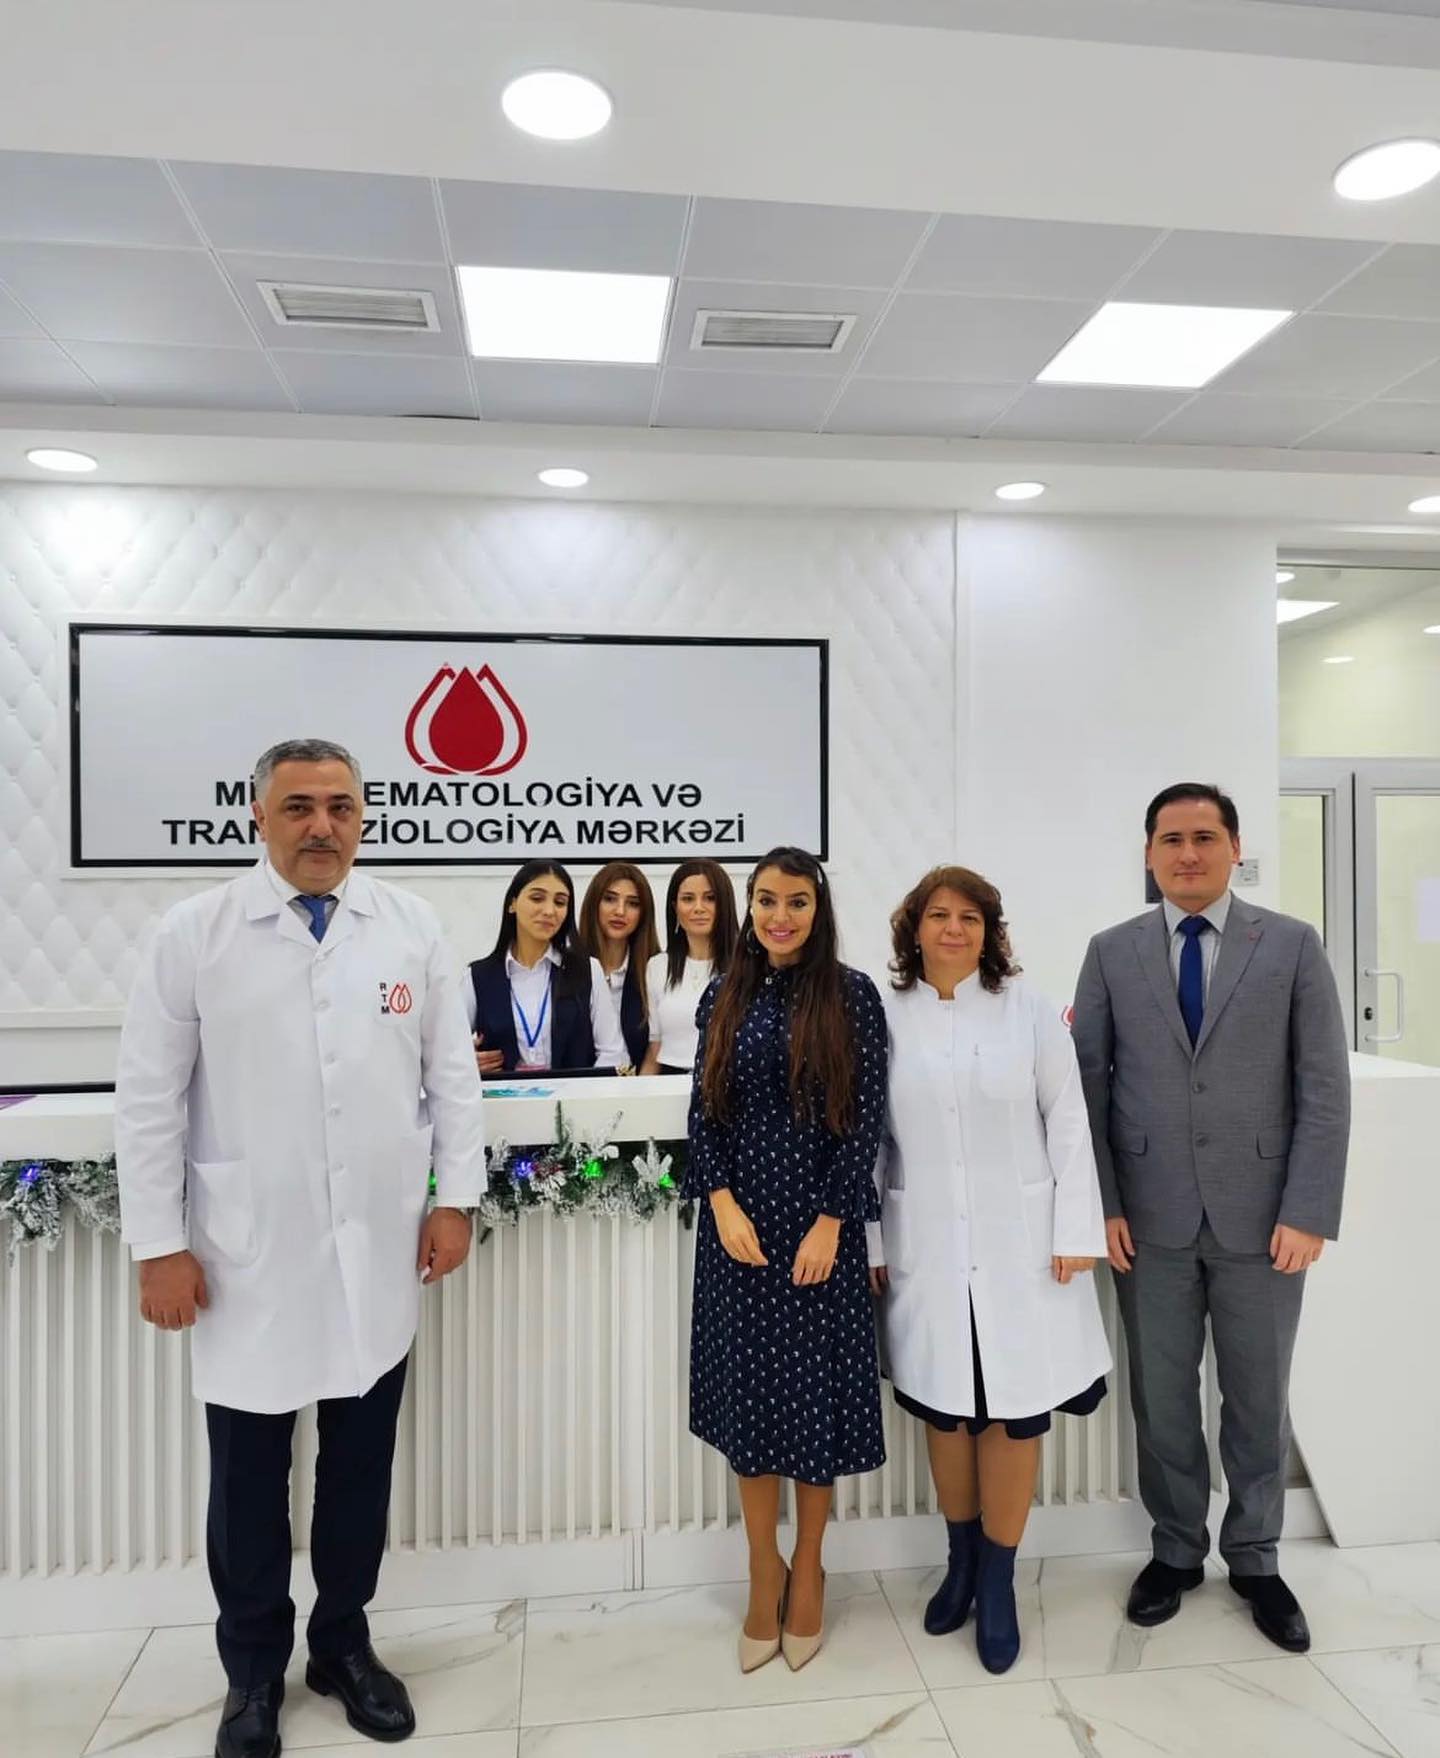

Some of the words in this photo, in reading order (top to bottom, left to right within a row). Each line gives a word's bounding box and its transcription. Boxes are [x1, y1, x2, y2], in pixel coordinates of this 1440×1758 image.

[363, 776, 643, 807] EMATOLOGİYA
[651, 783, 702, 808] VƏ
[576, 813, 745, 845] MƏRKƏZİ
[379, 982, 390, 1015] RTM
